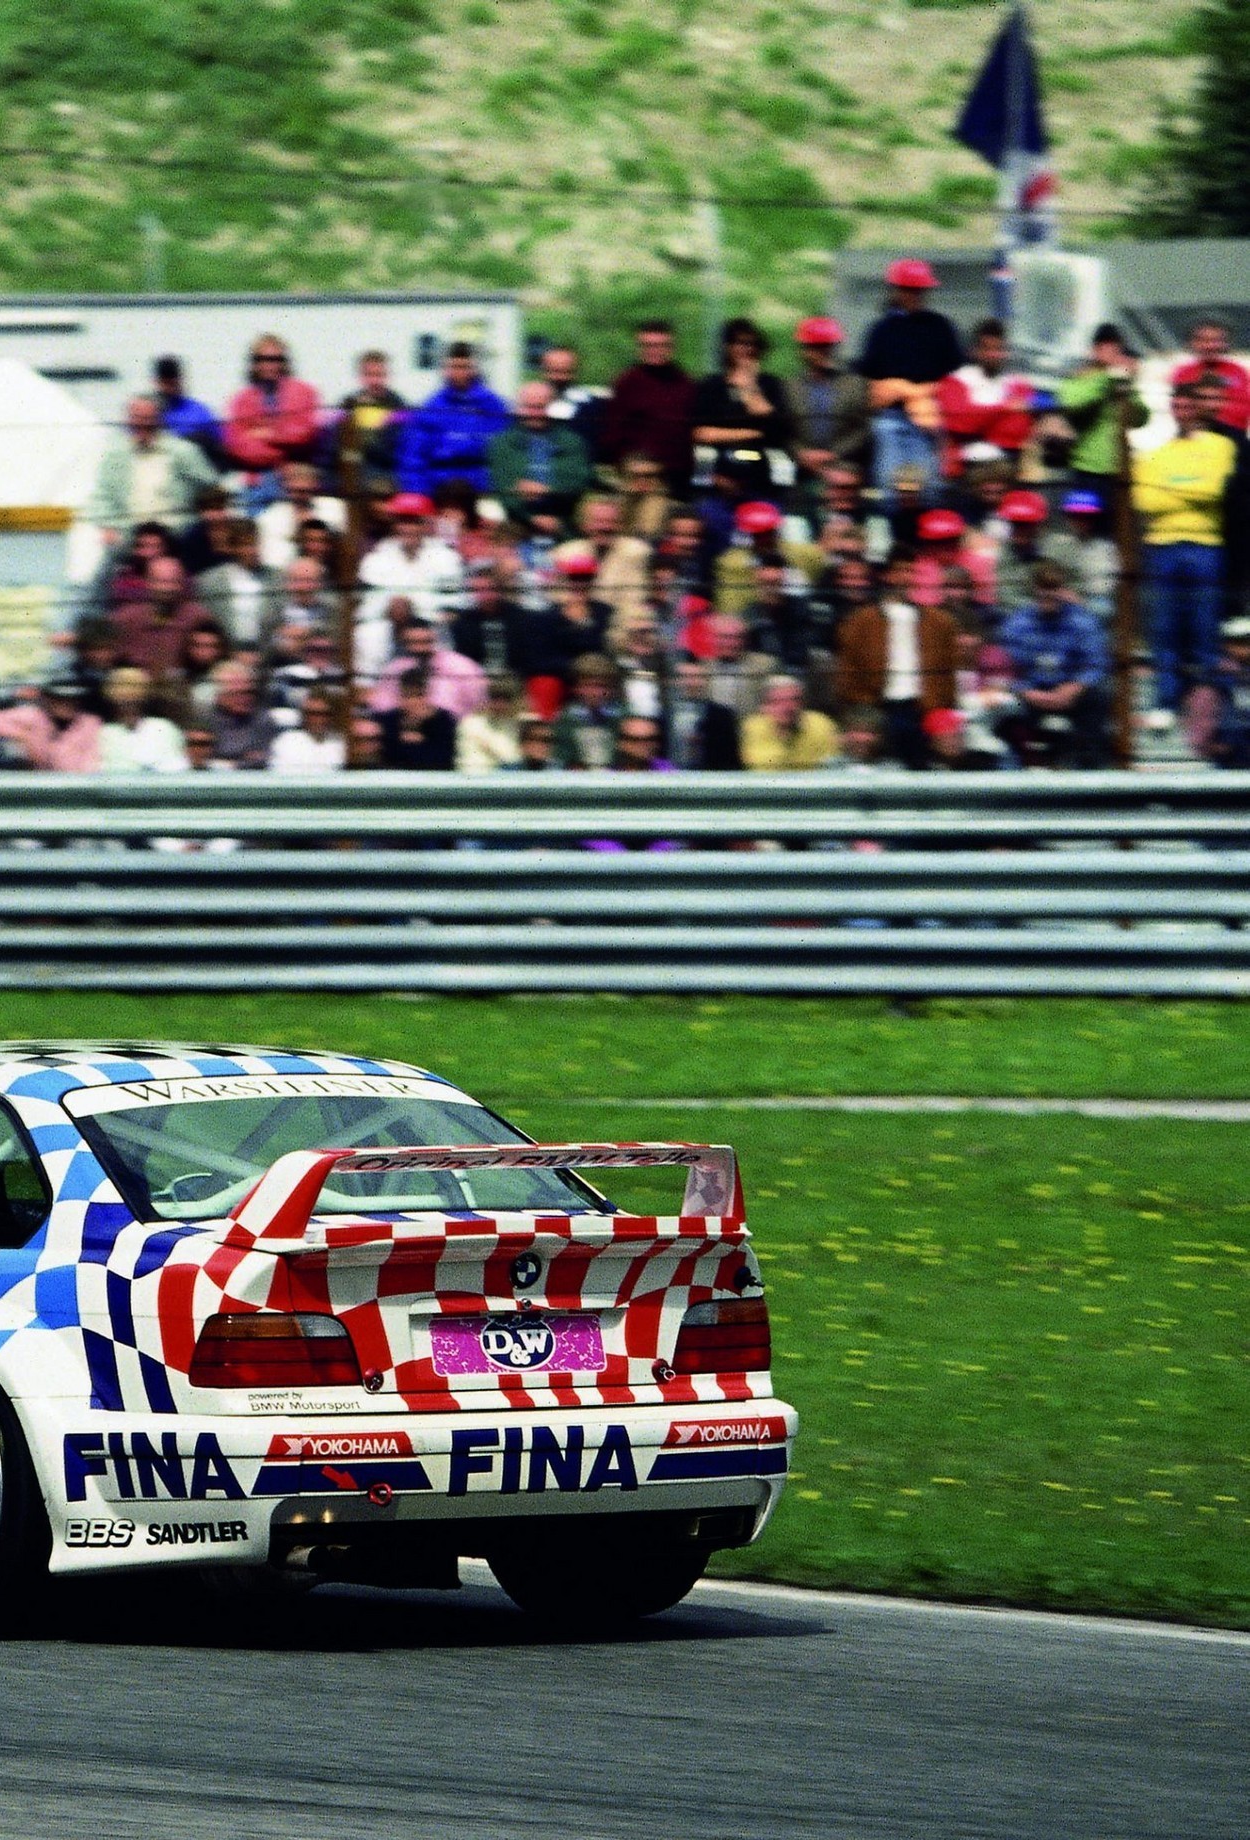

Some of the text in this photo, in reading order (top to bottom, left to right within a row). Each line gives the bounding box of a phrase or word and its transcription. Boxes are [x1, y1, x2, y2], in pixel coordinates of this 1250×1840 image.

[119, 1079, 420, 1102] WARSTEINER
[511, 1154, 613, 1168] BMW
[483, 1328, 551, 1366] D&W
[247, 1391, 303, 1401] powered by
[250, 1400, 362, 1412] BMW Motorsport
[698, 1421, 771, 1443] YOKOHAMA
[310, 1436, 400, 1456] YOKOHAMA
[63, 1432, 248, 1502] FINA
[447, 1424, 639, 1497] FINA
[64, 1518, 136, 1548] BBS
[146, 1519, 249, 1546] SANDTLER
